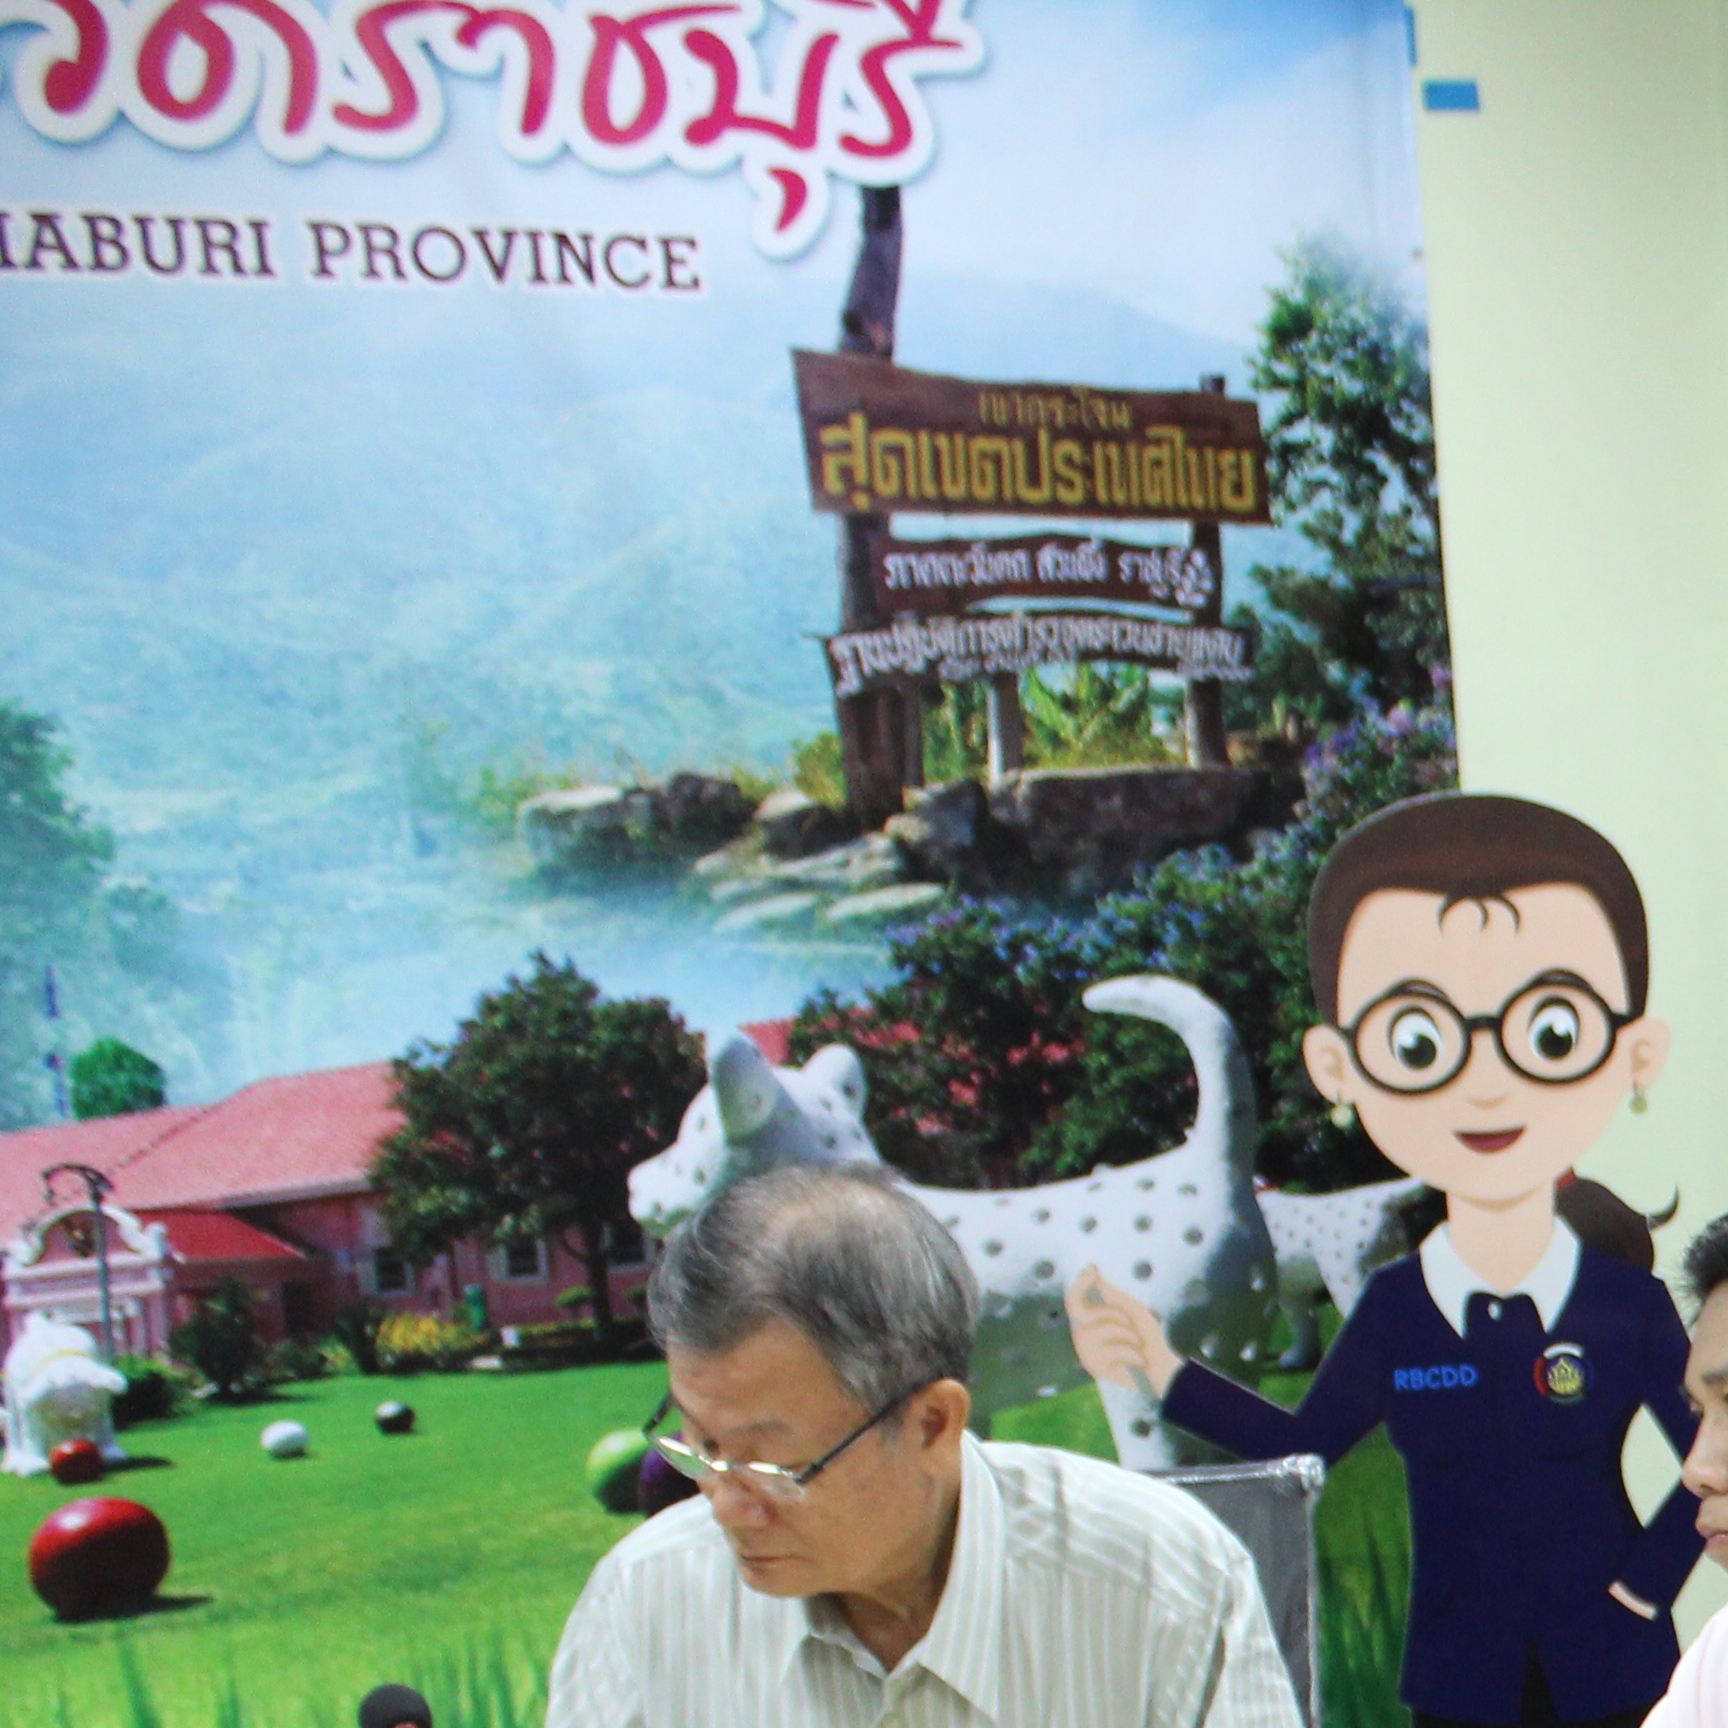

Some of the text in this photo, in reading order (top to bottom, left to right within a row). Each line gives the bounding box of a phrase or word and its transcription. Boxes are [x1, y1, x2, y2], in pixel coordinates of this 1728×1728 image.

[311, 220, 702, 291] PROVINCE
[818, 411, 1259, 513] สุดเขตประเทศไทย
[1393, 1363, 1480, 1391] RBCDD
